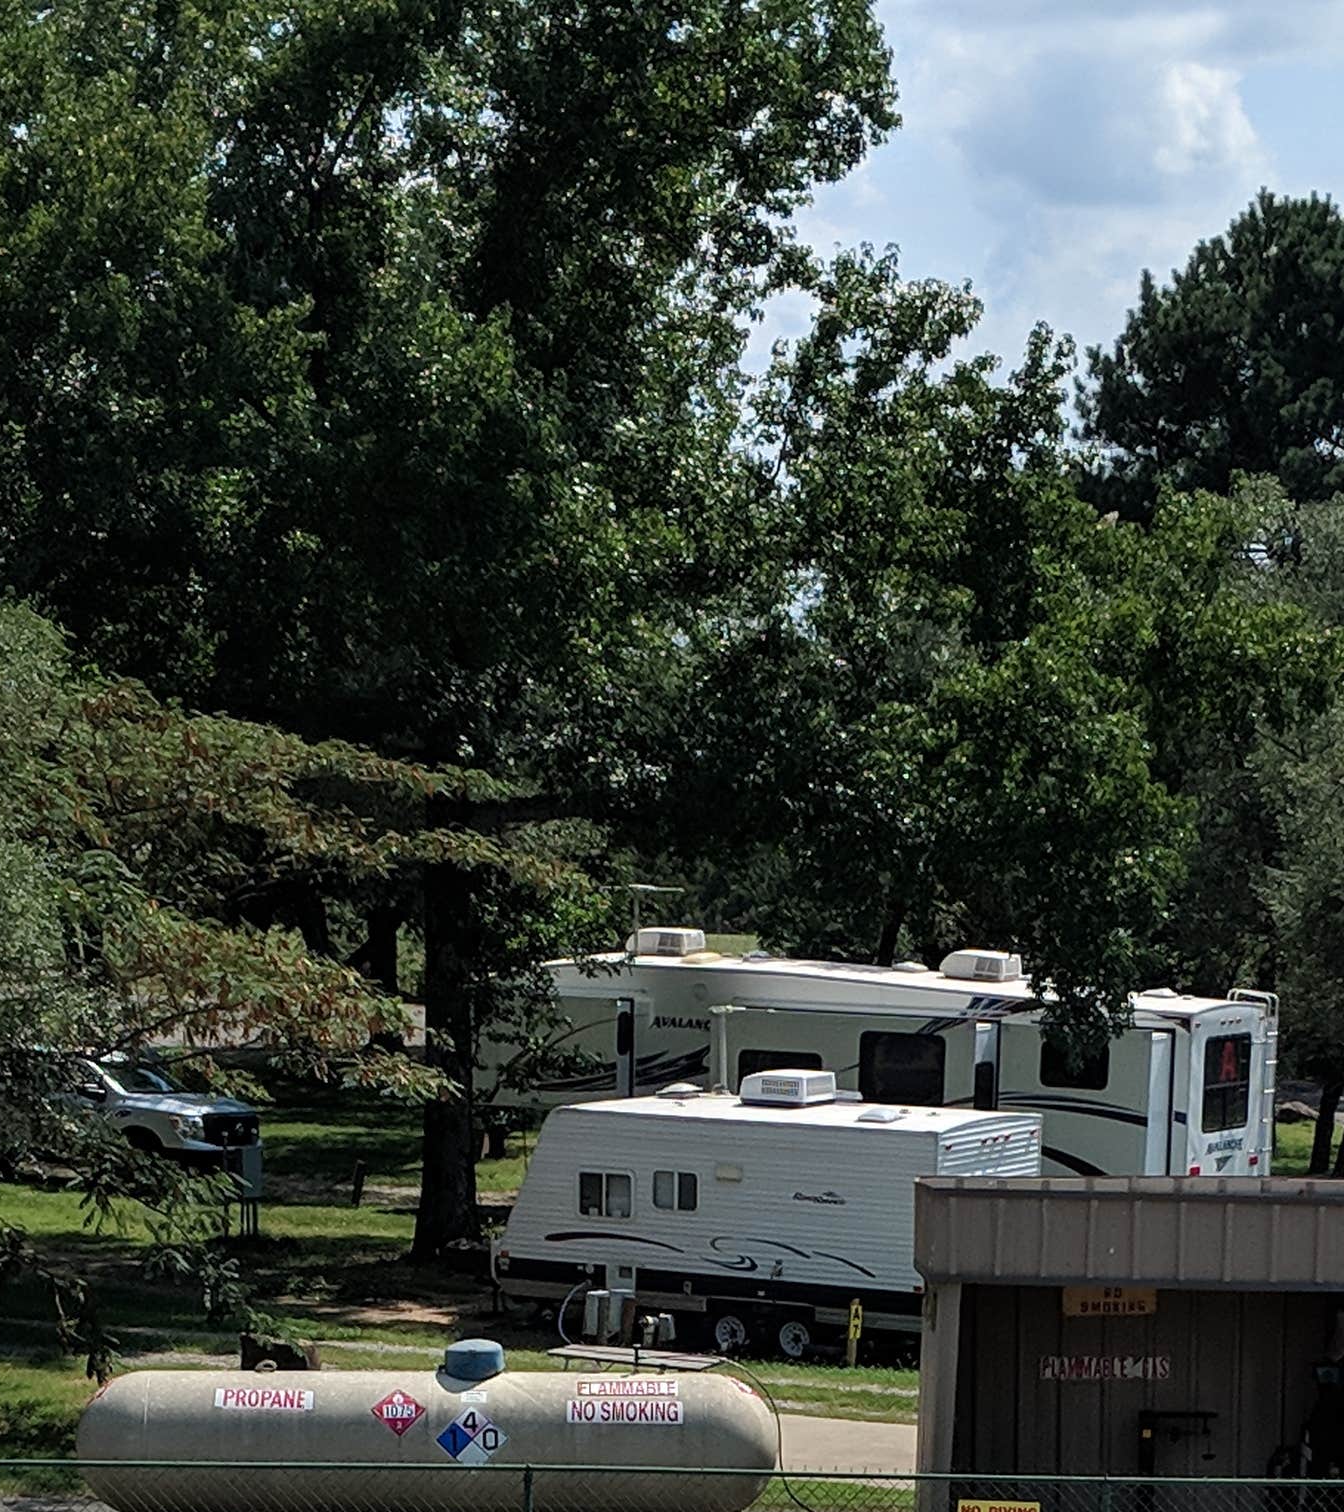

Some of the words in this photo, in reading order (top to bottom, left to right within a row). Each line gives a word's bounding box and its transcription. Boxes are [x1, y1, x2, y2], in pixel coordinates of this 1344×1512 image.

[1080, 1300, 1147, 1313] SMOKING
[1041, 1356, 1129, 1380] FLAMMABLE
[222, 1388, 306, 1409] PROPANE
[577, 1381, 677, 1396] FLAMMABLE
[385, 1404, 414, 1418] 1075
[571, 1401, 596, 1422] NO
[600, 1401, 679, 1422] SMOKING
[462, 1411, 478, 1433] 4
[482, 1428, 499, 1451] 0
